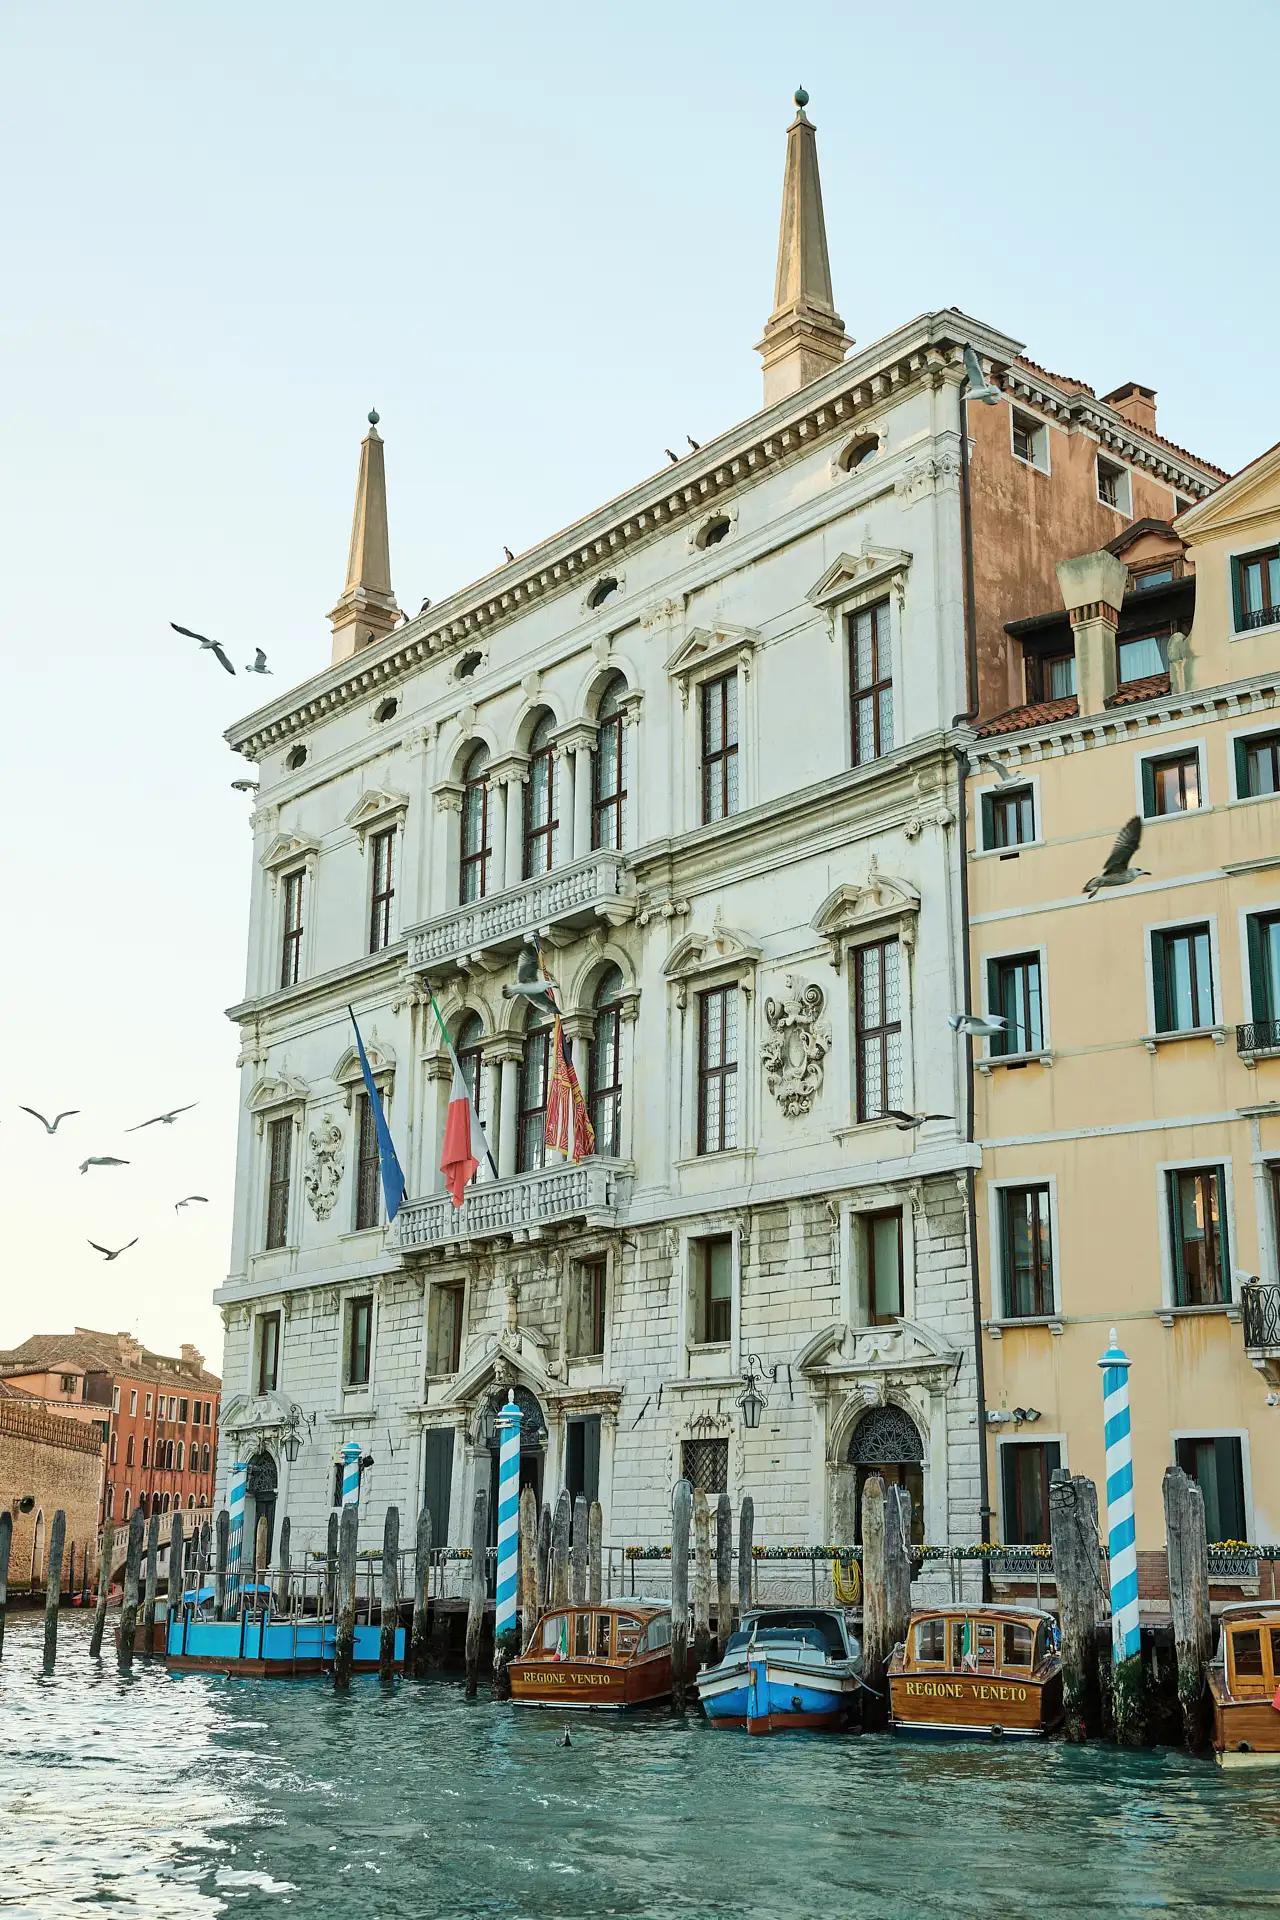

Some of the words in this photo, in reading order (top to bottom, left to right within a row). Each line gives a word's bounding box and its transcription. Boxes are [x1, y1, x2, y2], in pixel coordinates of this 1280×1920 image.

[523, 1671, 566, 1684] REGIONE
[570, 1673, 610, 1685] VENETO
[906, 1682, 964, 1698] REGIONE
[971, 1685, 1027, 1702] VENETO
